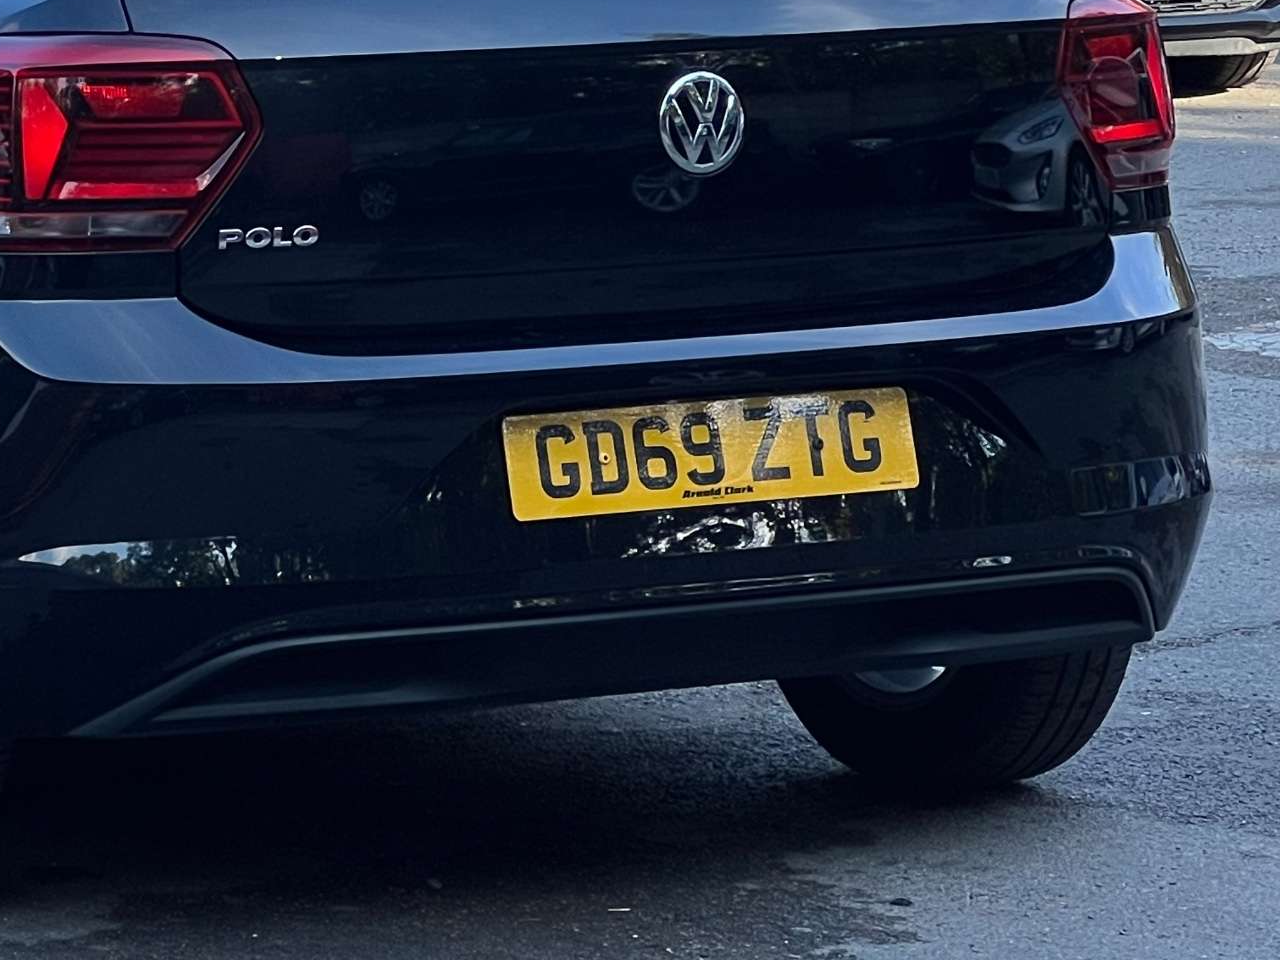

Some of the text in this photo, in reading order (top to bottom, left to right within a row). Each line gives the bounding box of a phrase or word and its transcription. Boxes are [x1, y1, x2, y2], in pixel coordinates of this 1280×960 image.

[218, 224, 319, 250] POLO
[535, 399, 882, 499] GD69 ZTG
[682, 487, 722, 498] Arnold
[724, 485, 754, 495] Clark
